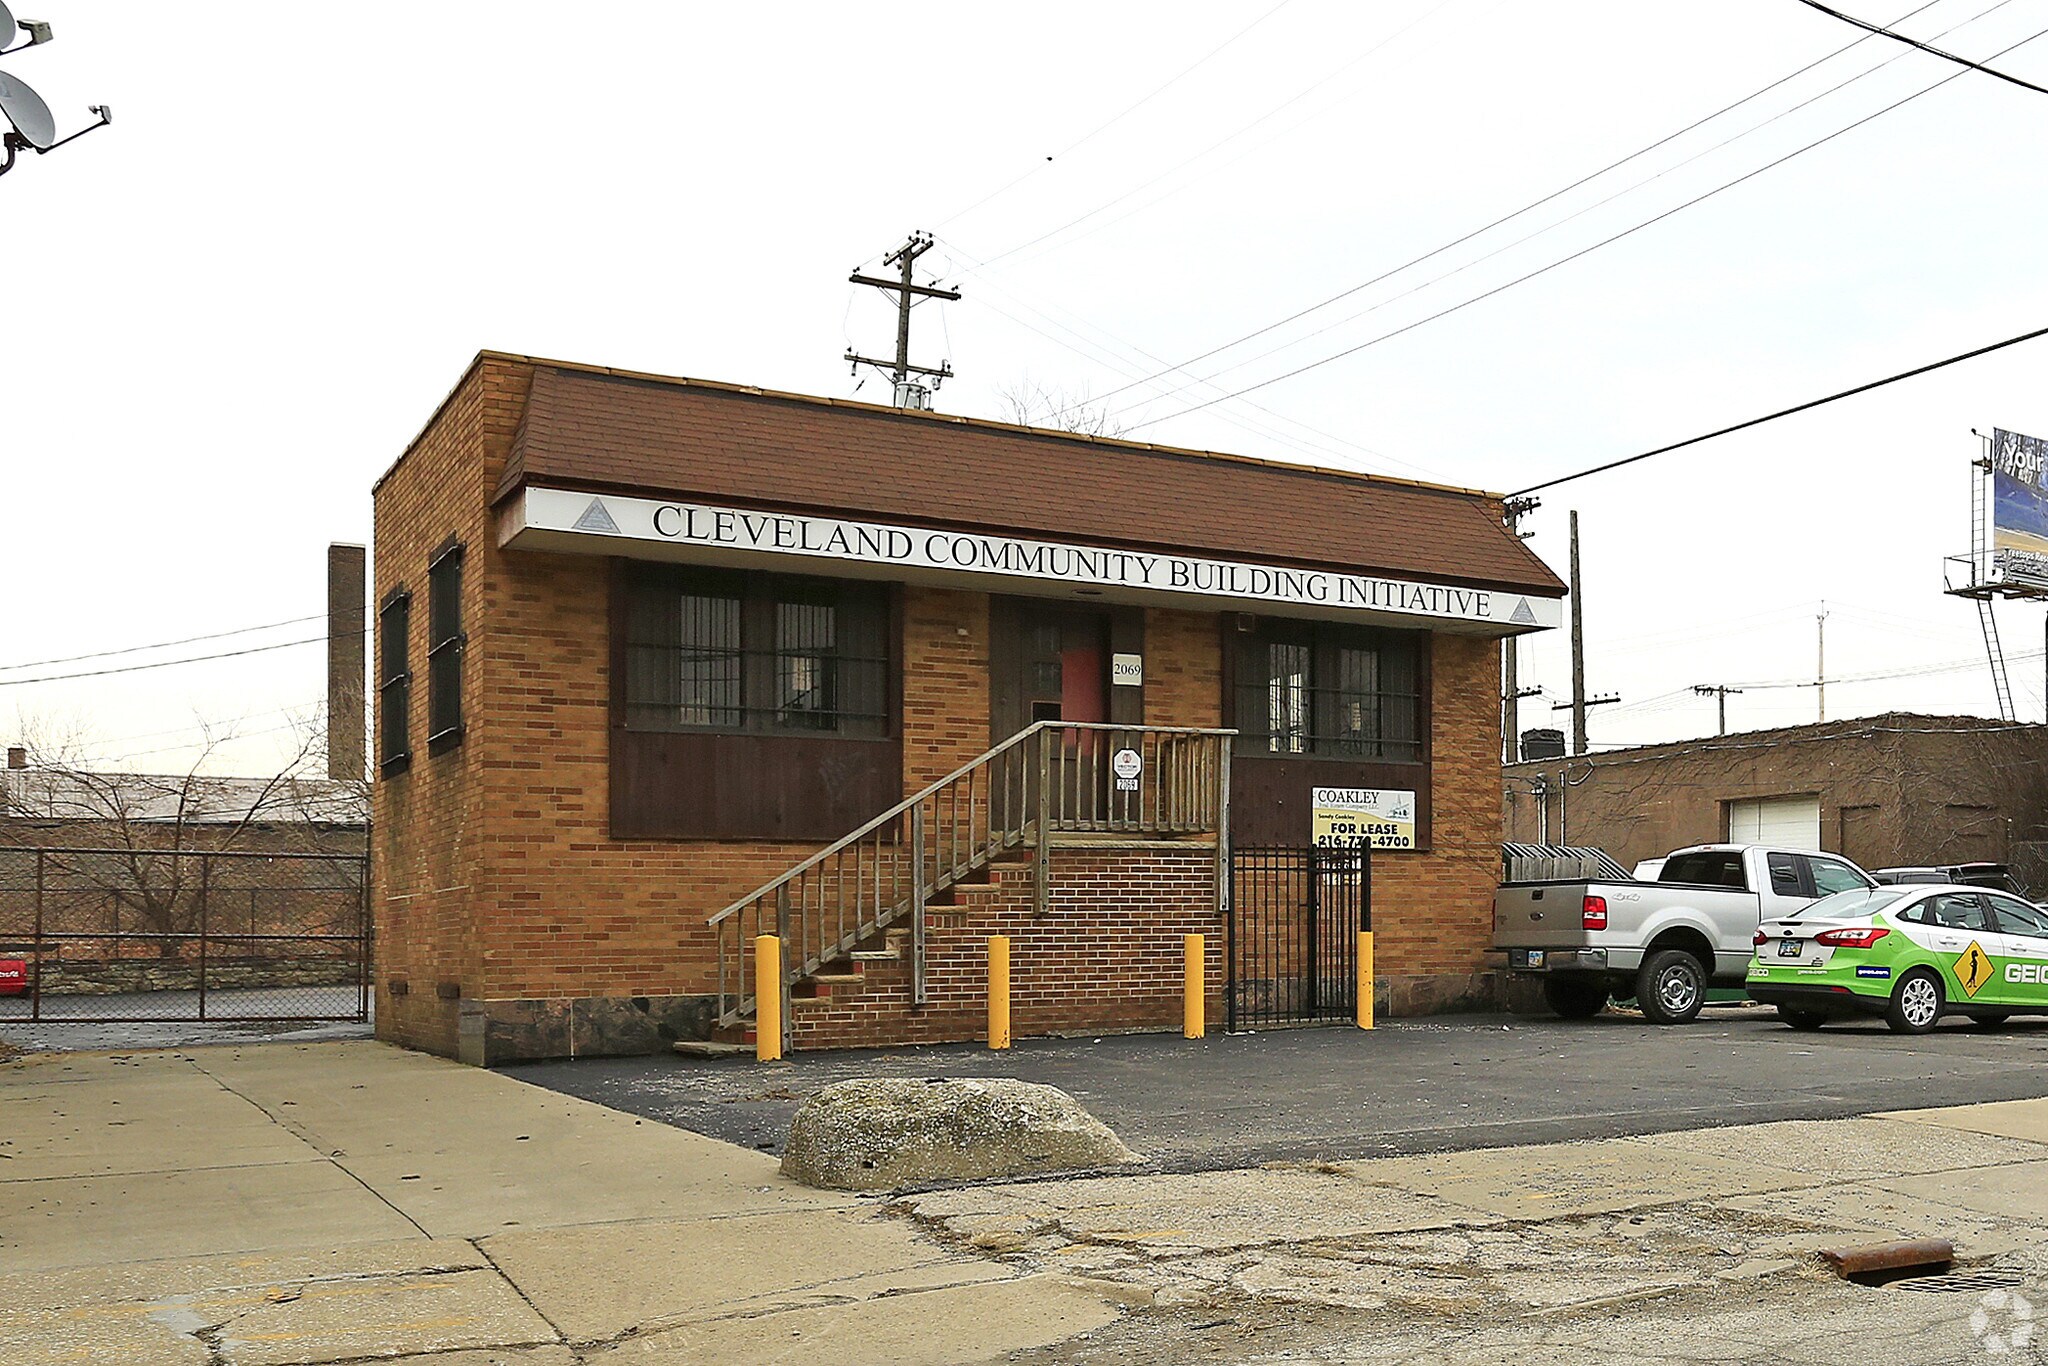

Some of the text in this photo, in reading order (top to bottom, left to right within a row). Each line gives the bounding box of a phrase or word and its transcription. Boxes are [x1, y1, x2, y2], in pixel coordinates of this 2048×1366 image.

[2003, 441, 2044, 472] Your
[652, 505, 1492, 618] CLEVELAND COMMUNITY BUILDING INITIATIVE
[1114, 663, 1141, 676] 2069
[1318, 790, 1380, 804] COAKLEY
[1331, 823, 1398, 835] FOR LEASE
[1319, 835, 1409, 848] 216-77-4700
